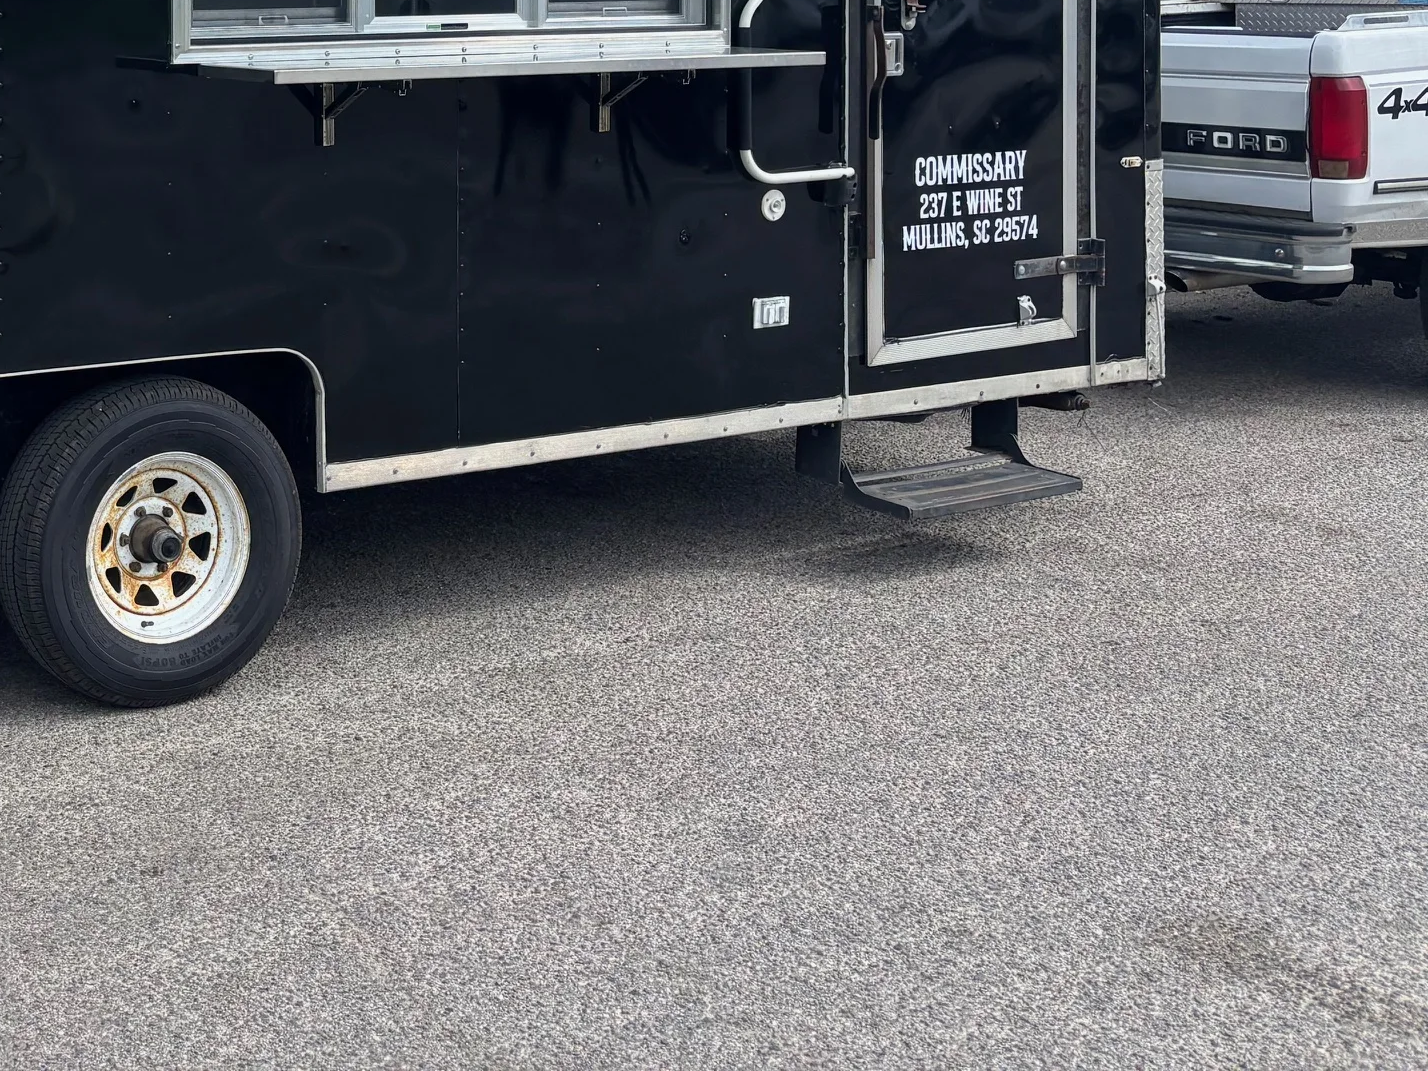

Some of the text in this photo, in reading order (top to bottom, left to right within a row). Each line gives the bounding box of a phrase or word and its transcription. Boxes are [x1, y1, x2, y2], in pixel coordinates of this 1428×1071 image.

[1186, 129, 1288, 153] FORD
[914, 149, 1027, 187] COMMISSARY
[919, 185, 1024, 219] 237 E WINE ST
[902, 214, 1039, 252] MULLINS, SC 29574
